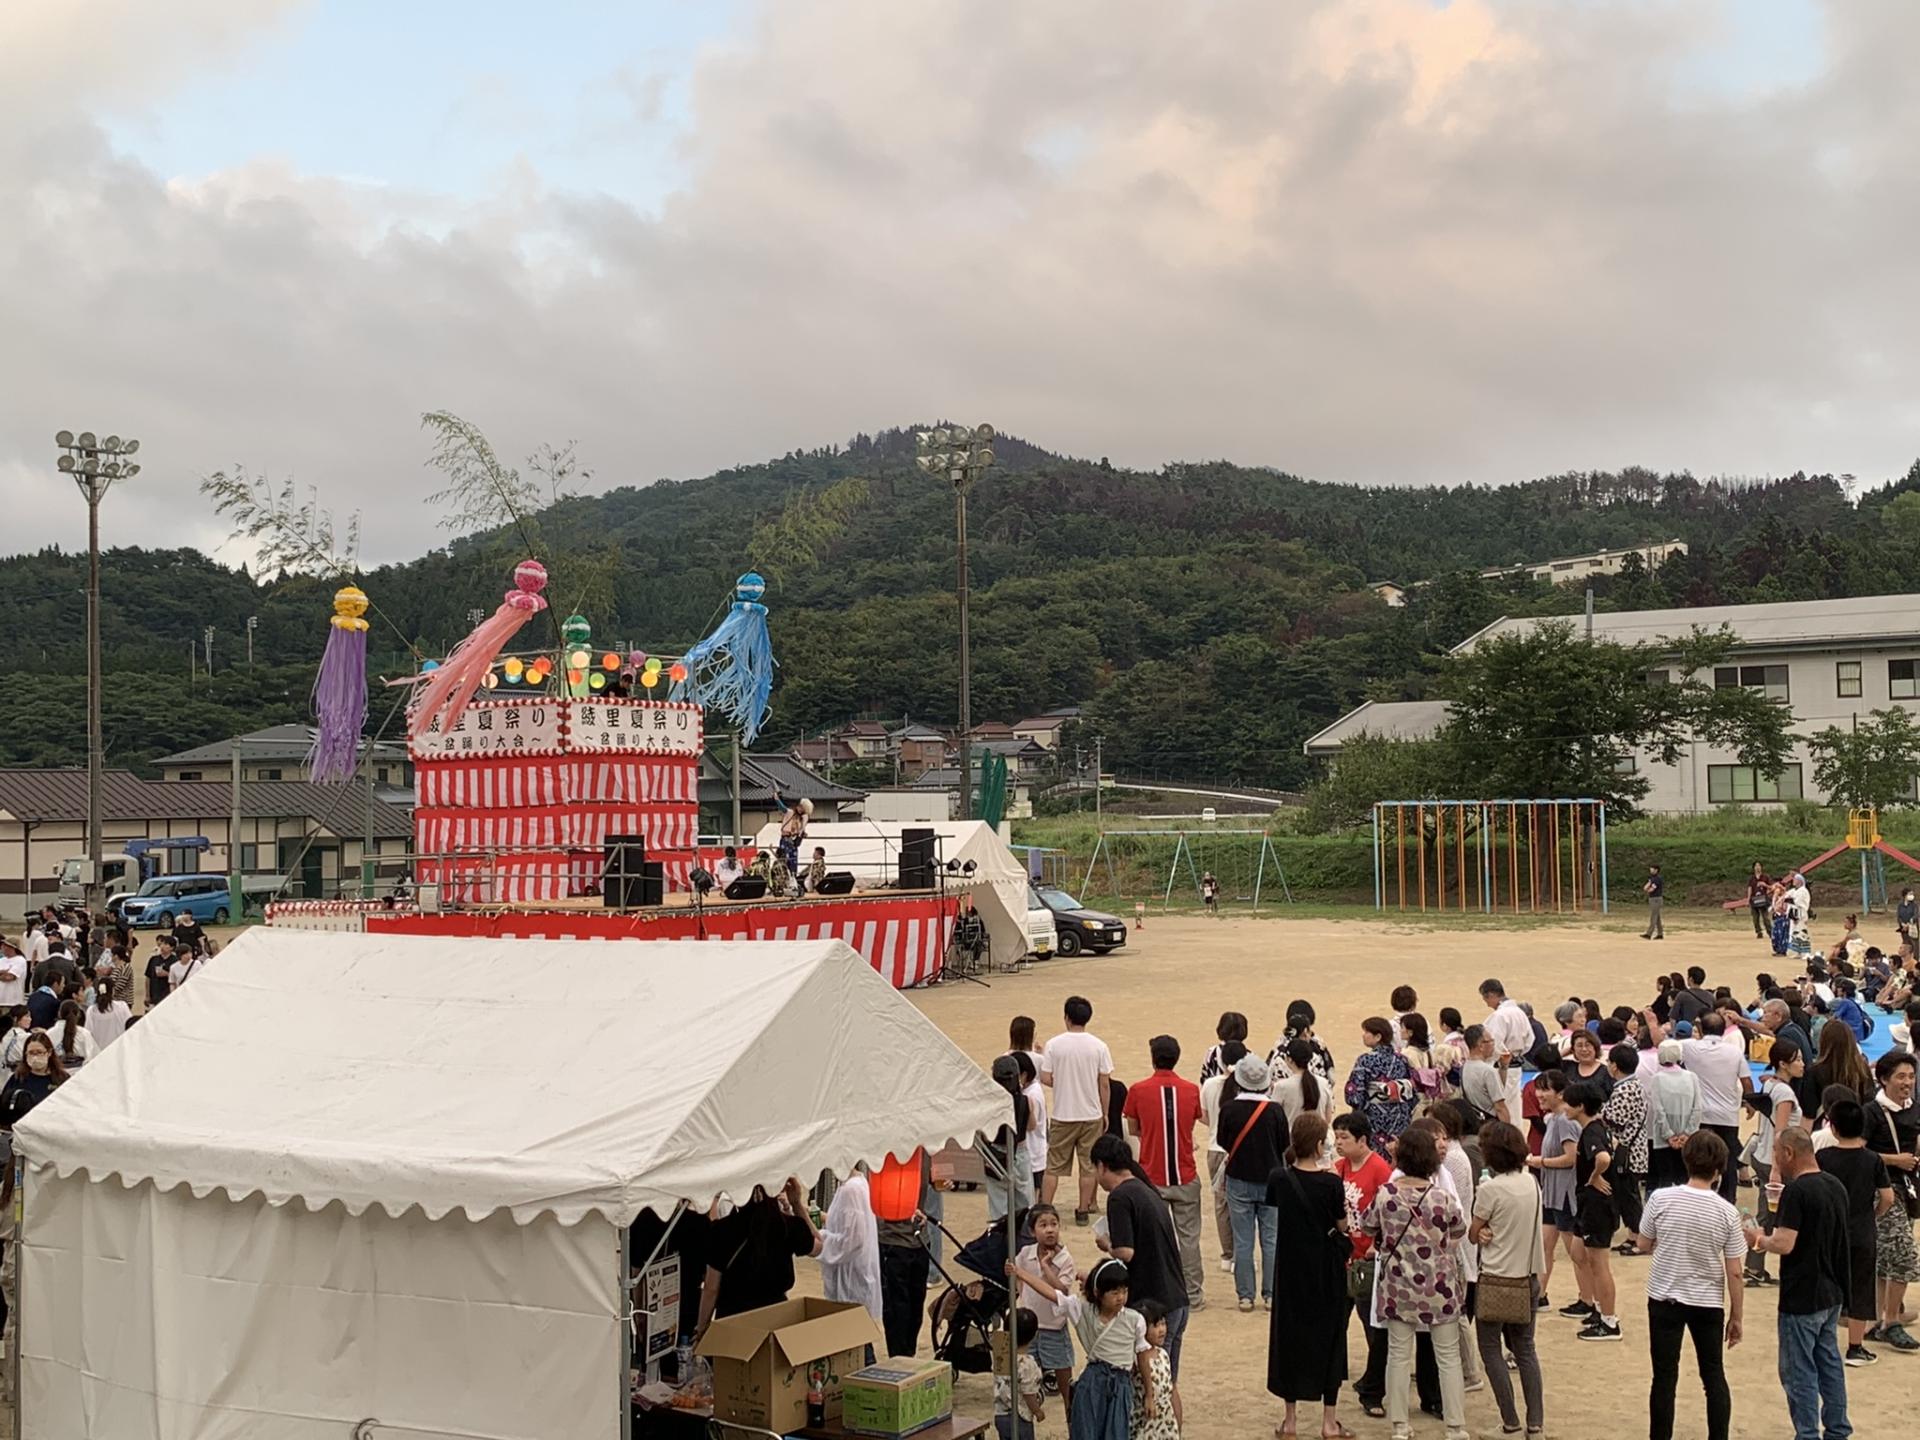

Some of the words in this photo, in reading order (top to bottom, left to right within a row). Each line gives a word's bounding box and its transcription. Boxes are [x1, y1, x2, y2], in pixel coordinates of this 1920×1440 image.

[581, 706, 688, 731] 綾里夏祭り
